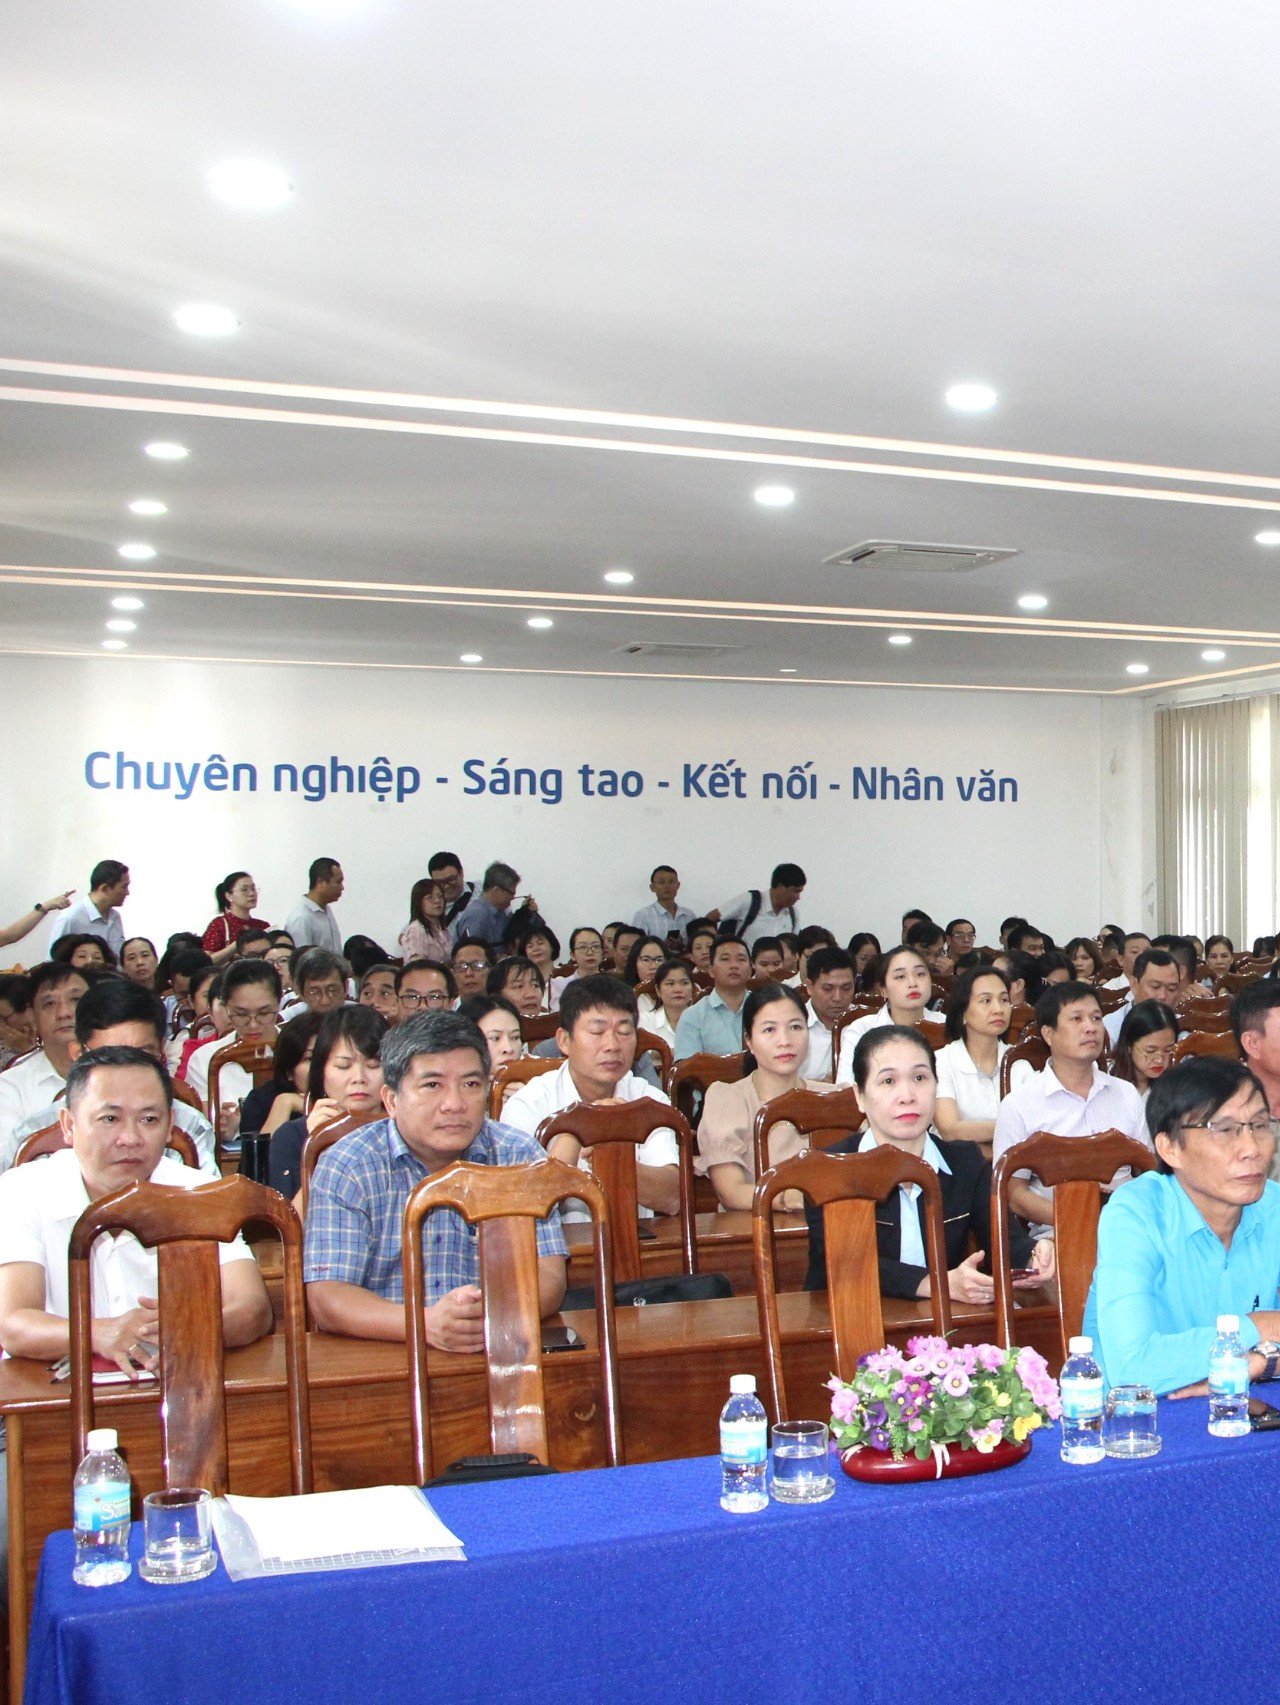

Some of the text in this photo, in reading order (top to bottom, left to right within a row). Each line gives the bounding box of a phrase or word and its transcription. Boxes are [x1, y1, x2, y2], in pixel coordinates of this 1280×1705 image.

[84, 751, 258, 801] Chuyên
[463, 757, 564, 805] Sáng
[683, 759, 747, 799] Kết
[762, 761, 818, 800] nối
[853, 766, 945, 802] Nhân
[957, 769, 1018, 802] văn
